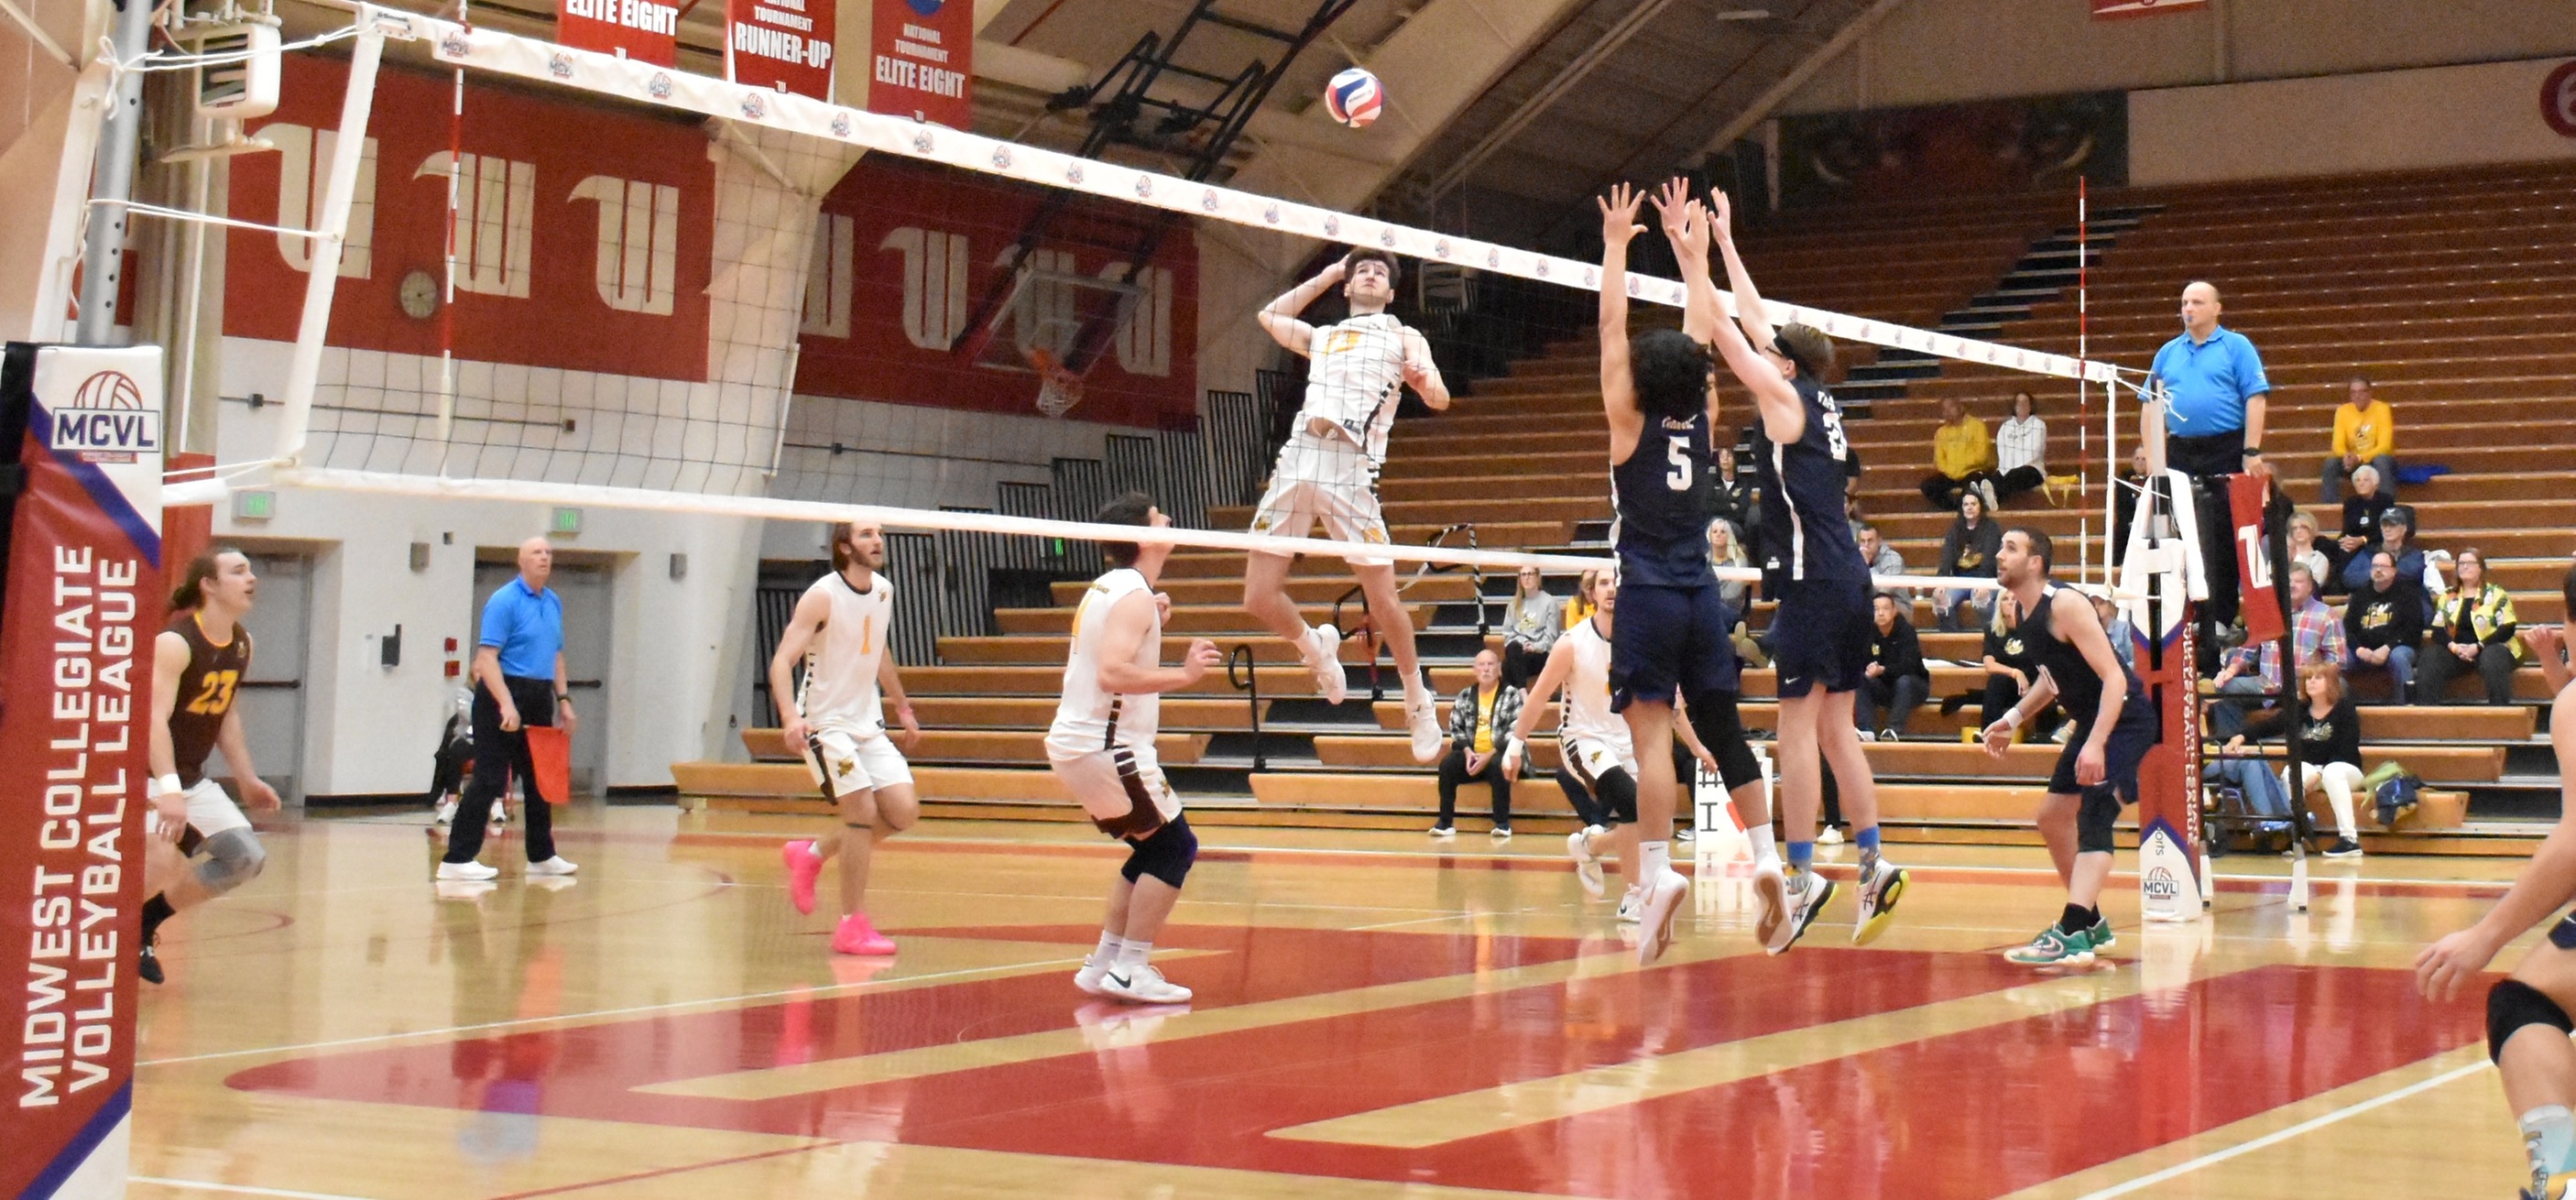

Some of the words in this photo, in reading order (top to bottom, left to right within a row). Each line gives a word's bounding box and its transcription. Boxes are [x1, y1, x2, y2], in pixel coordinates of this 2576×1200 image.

[566, 0, 617, 24] ELITE
[621, 0, 679, 36] EIGHT
[754, 5, 813, 32] TOURNAMENT
[735, 21, 832, 69] RUNNER-UP
[876, 55, 917, 89] ELITE
[919, 64, 966, 99] EIGHT
[58, 413, 155, 447] MCVL
[1666, 436, 1693, 491] 5
[94, 559, 137, 752] LEAGUE
[861, 615, 871, 655] 1
[40, 545, 93, 849] COLLEGIATE
[186, 669, 239, 715] 23
[2144, 881, 2177, 895] MCVL
[69, 768, 126, 1094] VOLLEYBALL
[20, 865, 74, 1107] MIDWEST
